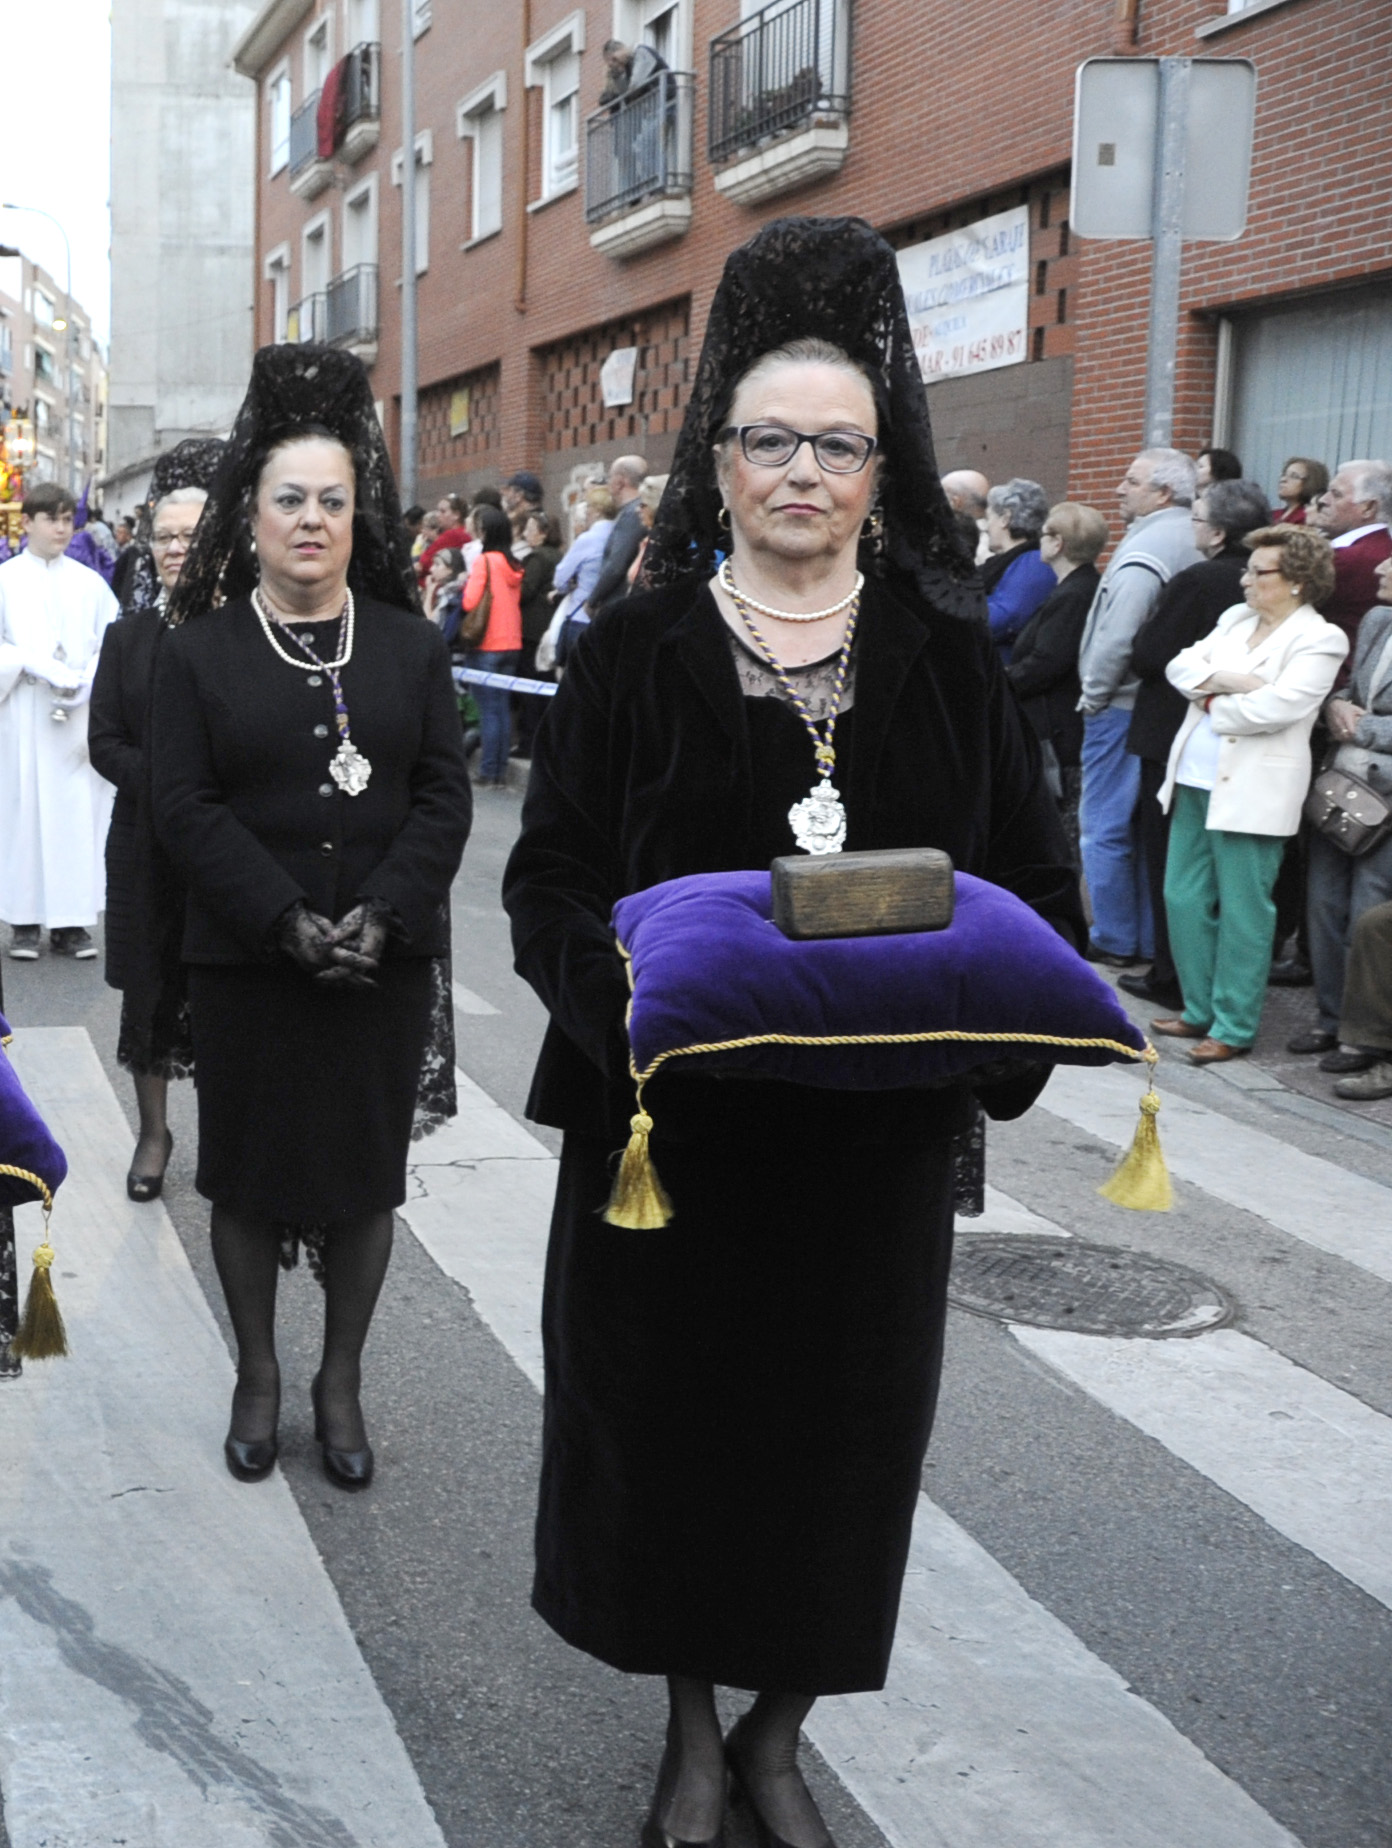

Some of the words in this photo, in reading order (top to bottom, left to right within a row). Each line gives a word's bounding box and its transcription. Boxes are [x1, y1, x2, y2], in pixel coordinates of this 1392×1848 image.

[952, 345, 965, 369] 91
[968, 338, 988, 364] 645
[990, 333, 1005, 360] 89
[1007, 329, 1023, 354] 87
